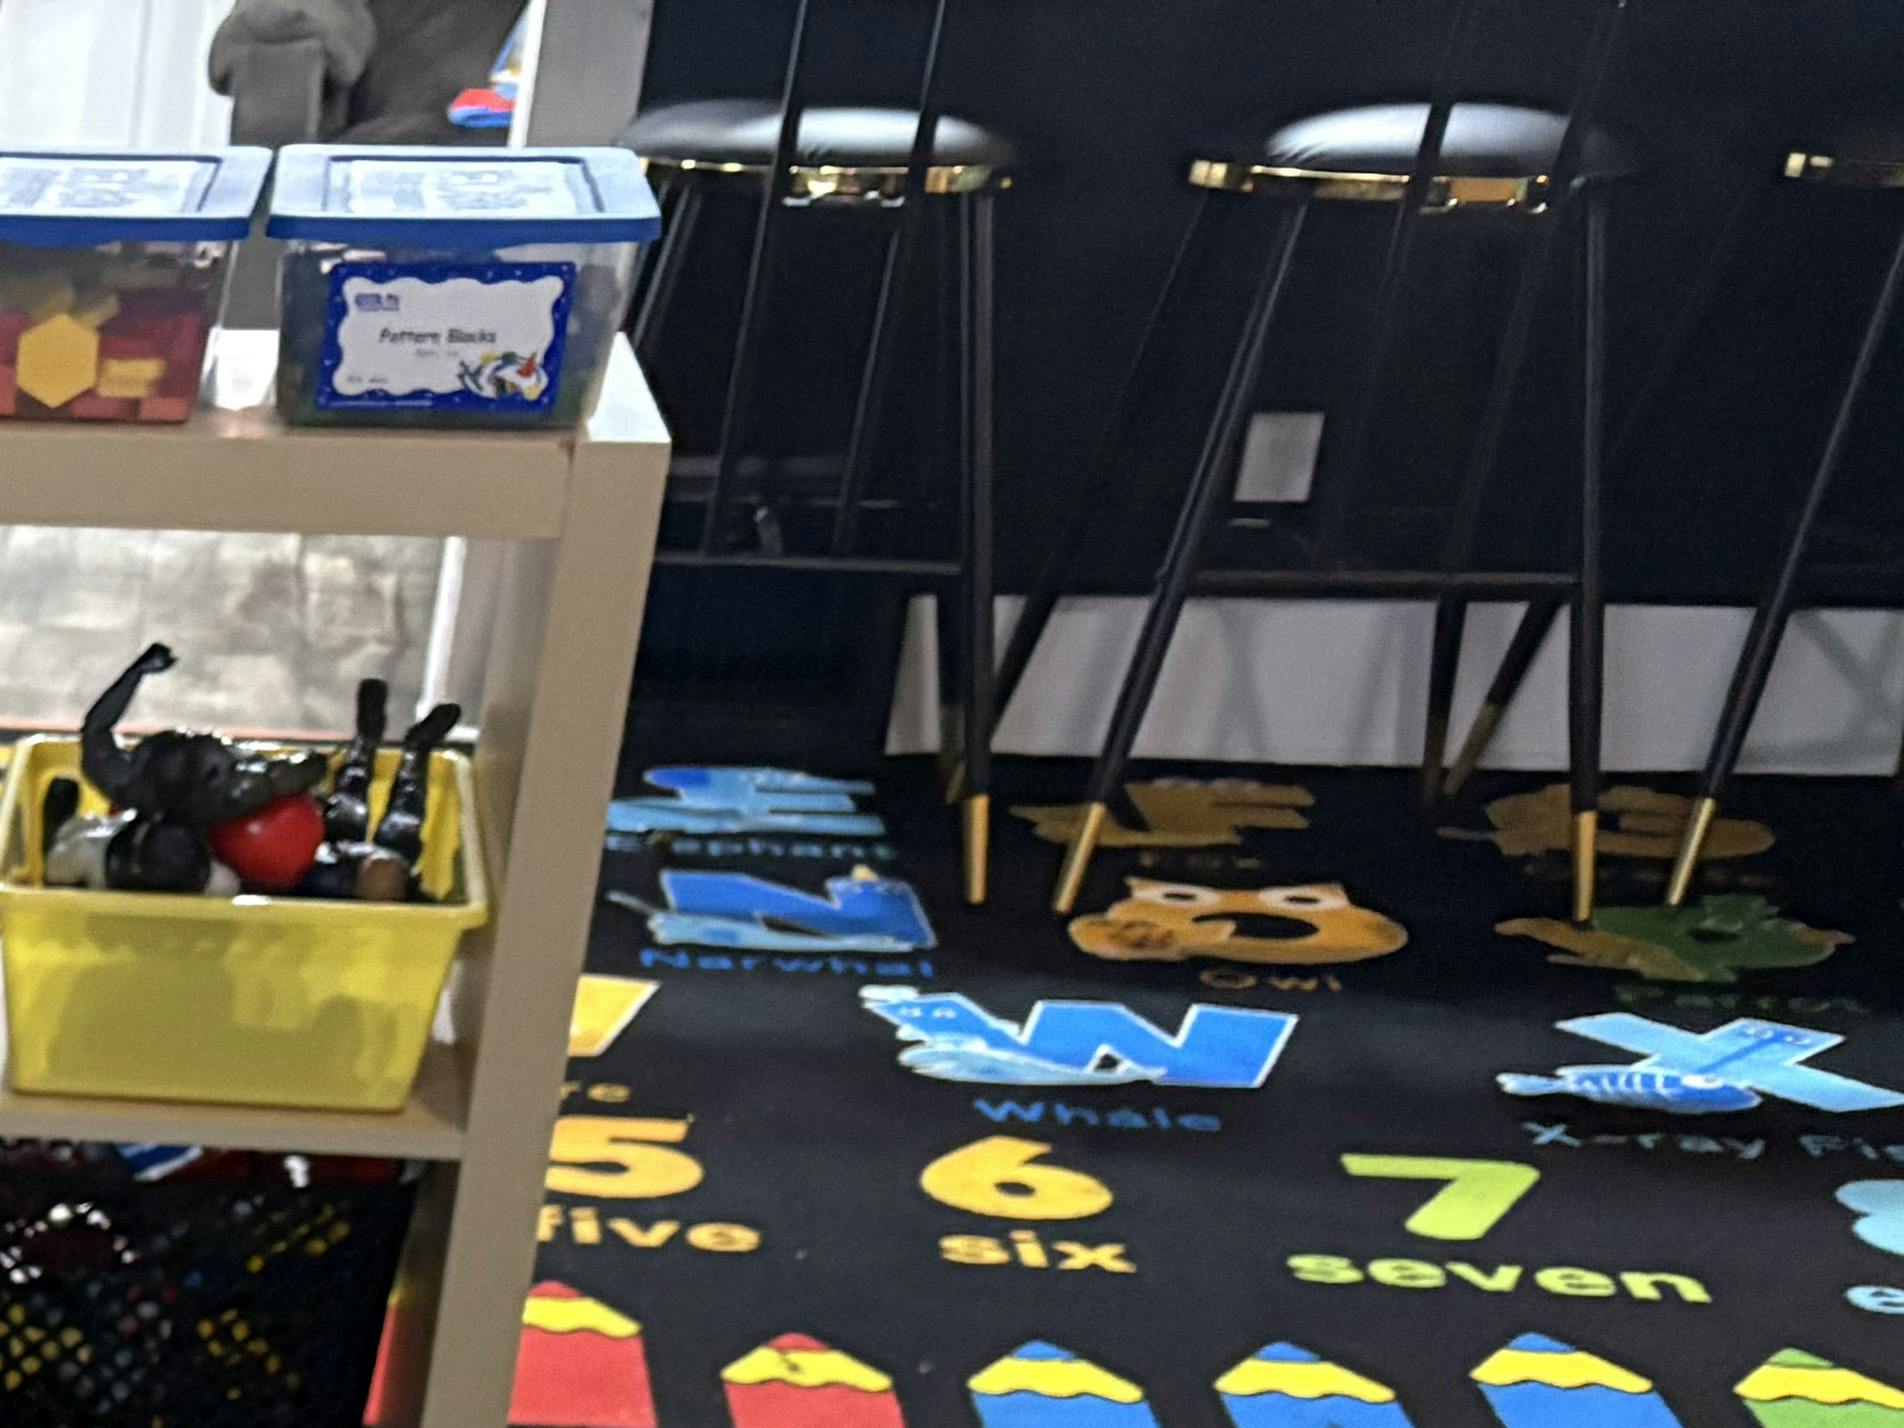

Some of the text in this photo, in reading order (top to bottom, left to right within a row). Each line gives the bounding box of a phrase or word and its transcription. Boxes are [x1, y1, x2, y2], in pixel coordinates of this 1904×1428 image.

[378, 327, 496, 344] Pattern Blocks
[606, 836, 894, 859] Eephant
[640, 948, 933, 977] Narwhal
[1199, 966, 1343, 992] Owl
[973, 1096, 1223, 1132] Whale
[544, 1115, 704, 1199] 5
[1523, 1120, 1767, 1160] X-ray
[920, 1135, 1114, 1220] 6
[1340, 1153, 1540, 1241] 7
[536, 1204, 763, 1253] five
[938, 1229, 1137, 1275] six
[1287, 1254, 1713, 1304] seven
